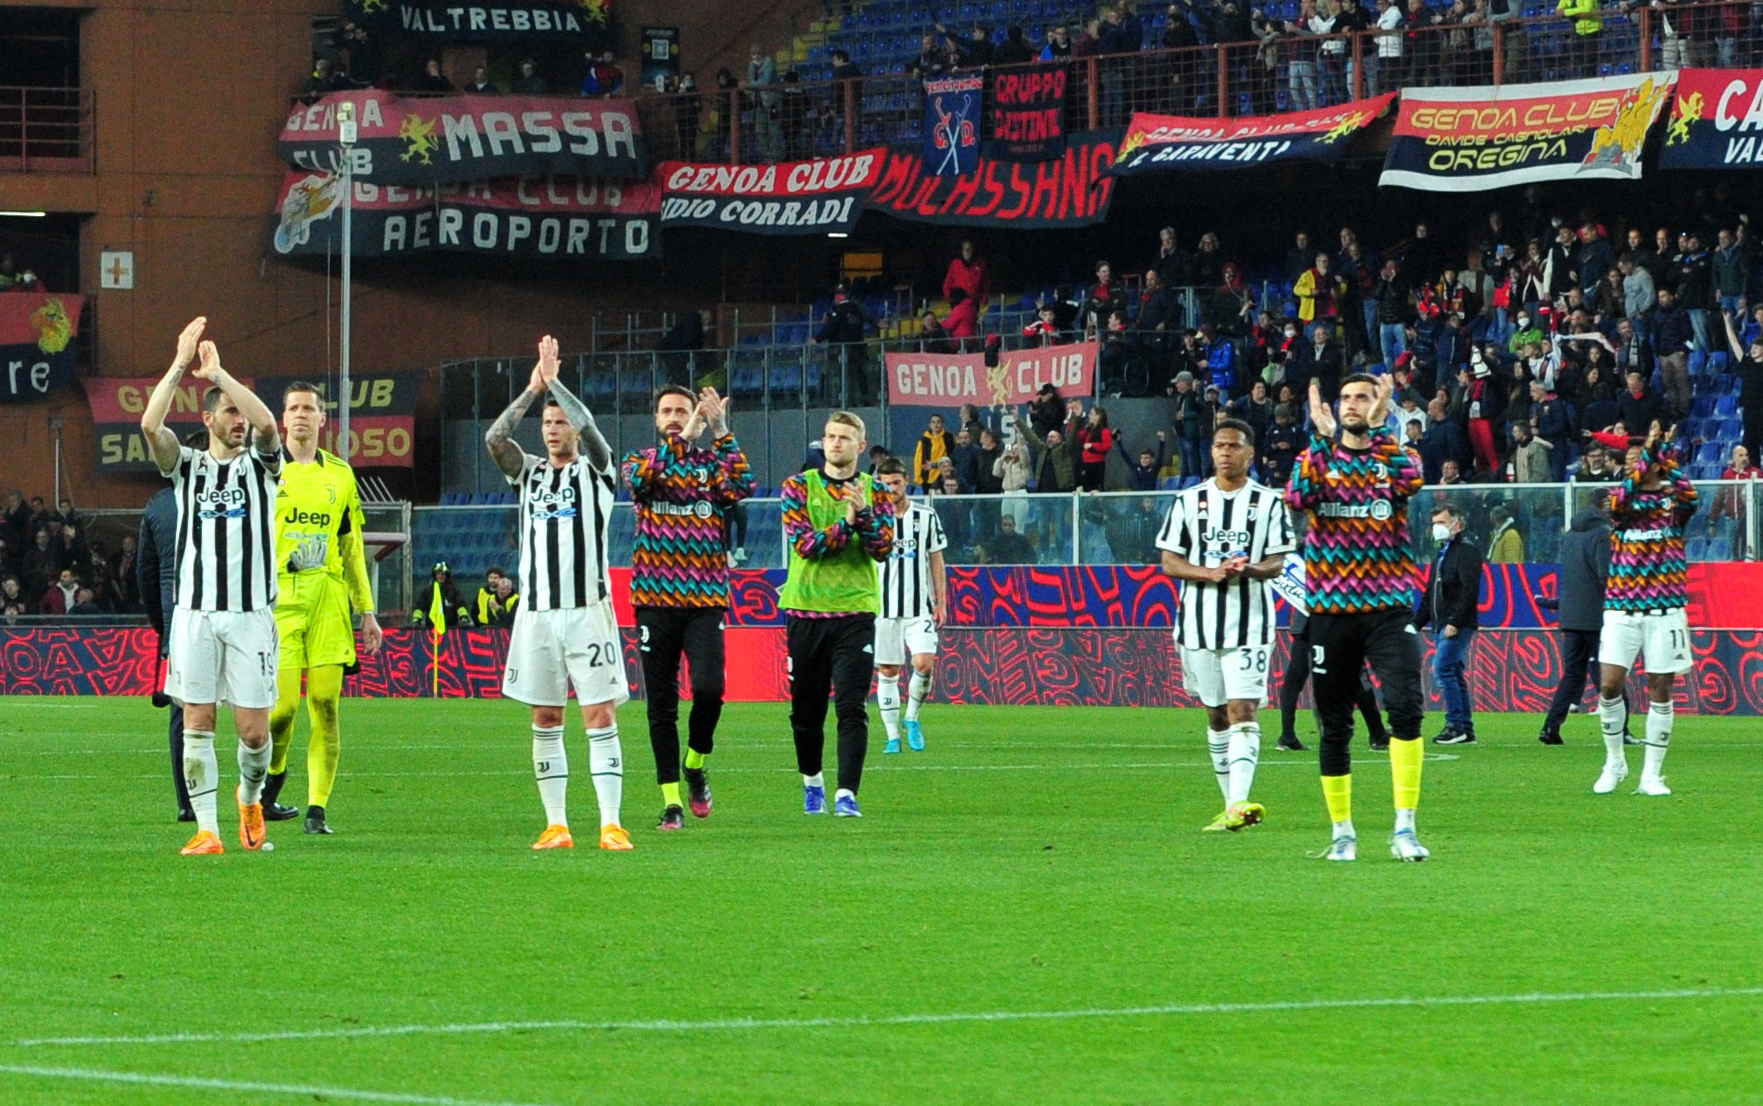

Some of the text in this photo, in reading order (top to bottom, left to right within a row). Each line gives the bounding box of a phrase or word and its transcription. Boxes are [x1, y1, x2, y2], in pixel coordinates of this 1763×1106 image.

[1411, 96, 1618, 131] GENOA CLUB
[440, 112, 638, 162] MASSA
[1425, 133, 1488, 148] DAVIDE
[1428, 138, 1568, 172] OREGINA
[668, 154, 875, 193] GENOA CLUB
[720, 197, 854, 227] CORRADI
[382, 208, 650, 255] AEROPORTO
[897, 353, 1084, 396] GENOA CLUB
[100, 433, 156, 465] SA
[198, 488, 244, 505] Jeep
[1318, 503, 1369, 518] Allianz
[285, 507, 331, 528] Jeep
[1205, 526, 1249, 545] Jeep
[1670, 629, 1686, 649] 11
[587, 642, 617, 668] 20
[1239, 649, 1267, 673] 38
